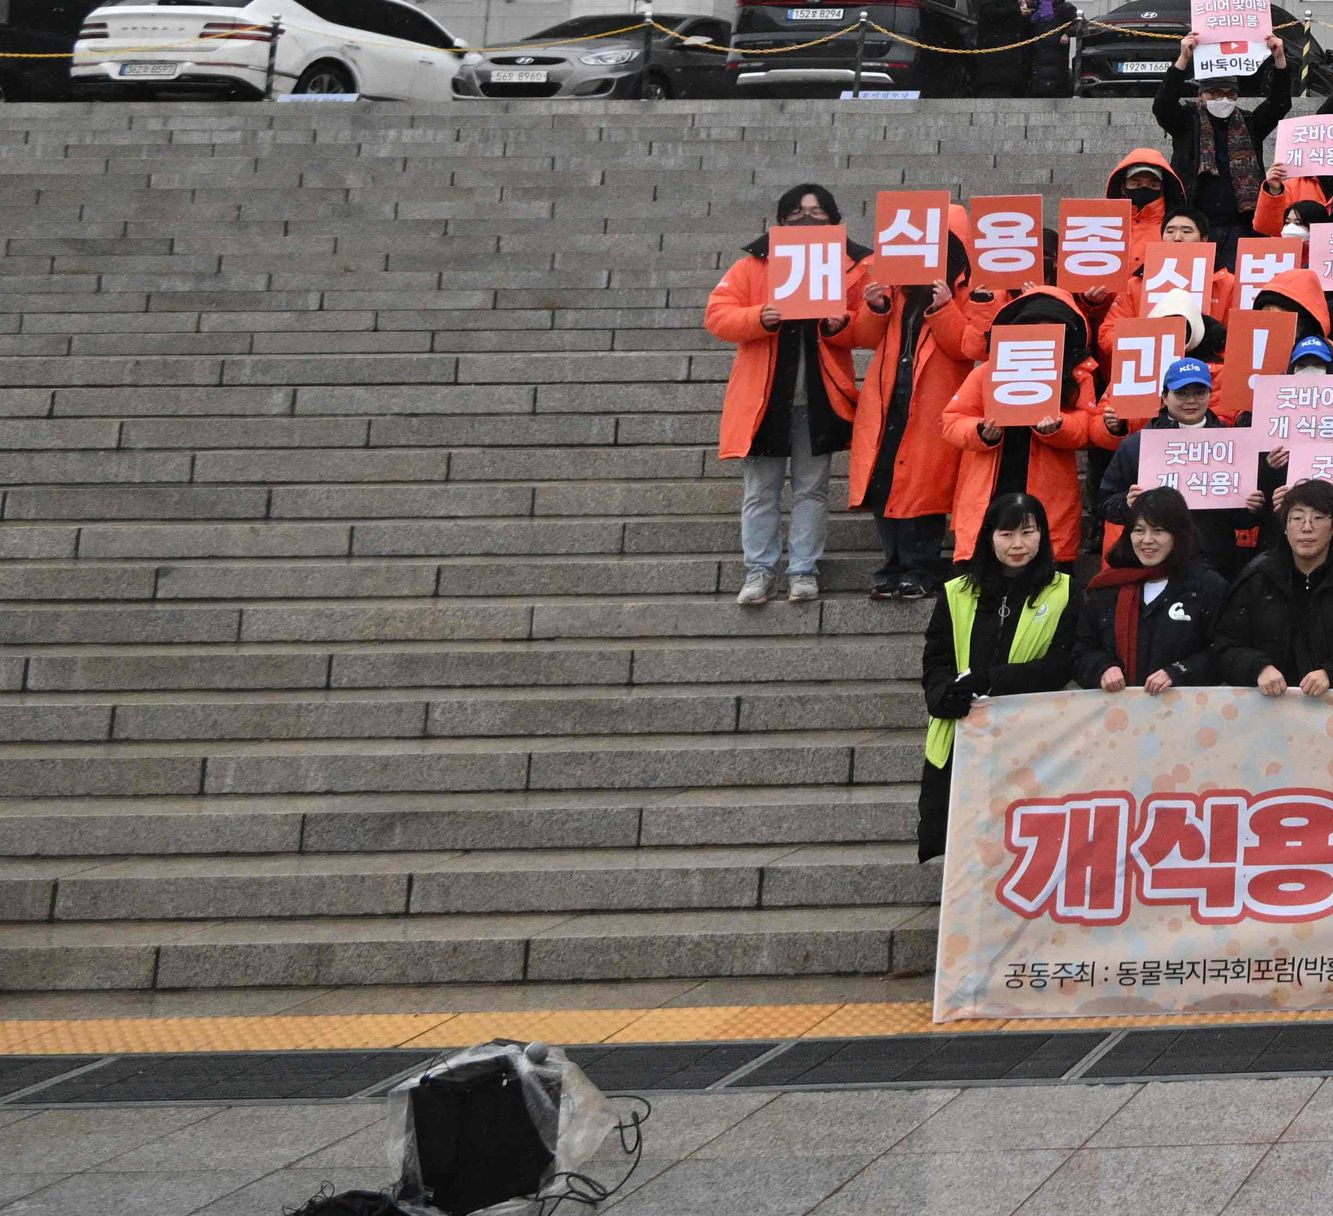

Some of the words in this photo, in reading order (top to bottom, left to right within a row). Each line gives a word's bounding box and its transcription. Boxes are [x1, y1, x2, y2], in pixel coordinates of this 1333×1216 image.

[820, 10, 842, 19] 8294
[1206, 14, 1244, 29] 우리의
[1246, 12, 1258, 27] 봄
[1286, 150, 1303, 167] 개
[879, 208, 940, 268] 식
[975, 212, 1038, 272] 용
[1062, 216, 1126, 277] 종
[774, 243, 842, 301] 개
[992, 340, 1057, 405] 통
[1268, 416, 1288, 438] 개
[1165, 440, 1233, 465] 굿바이
[1185, 473, 1239, 496] 식용!
[1001, 797, 1130, 919] 개
[1004, 960, 1096, 988] 공동주최
